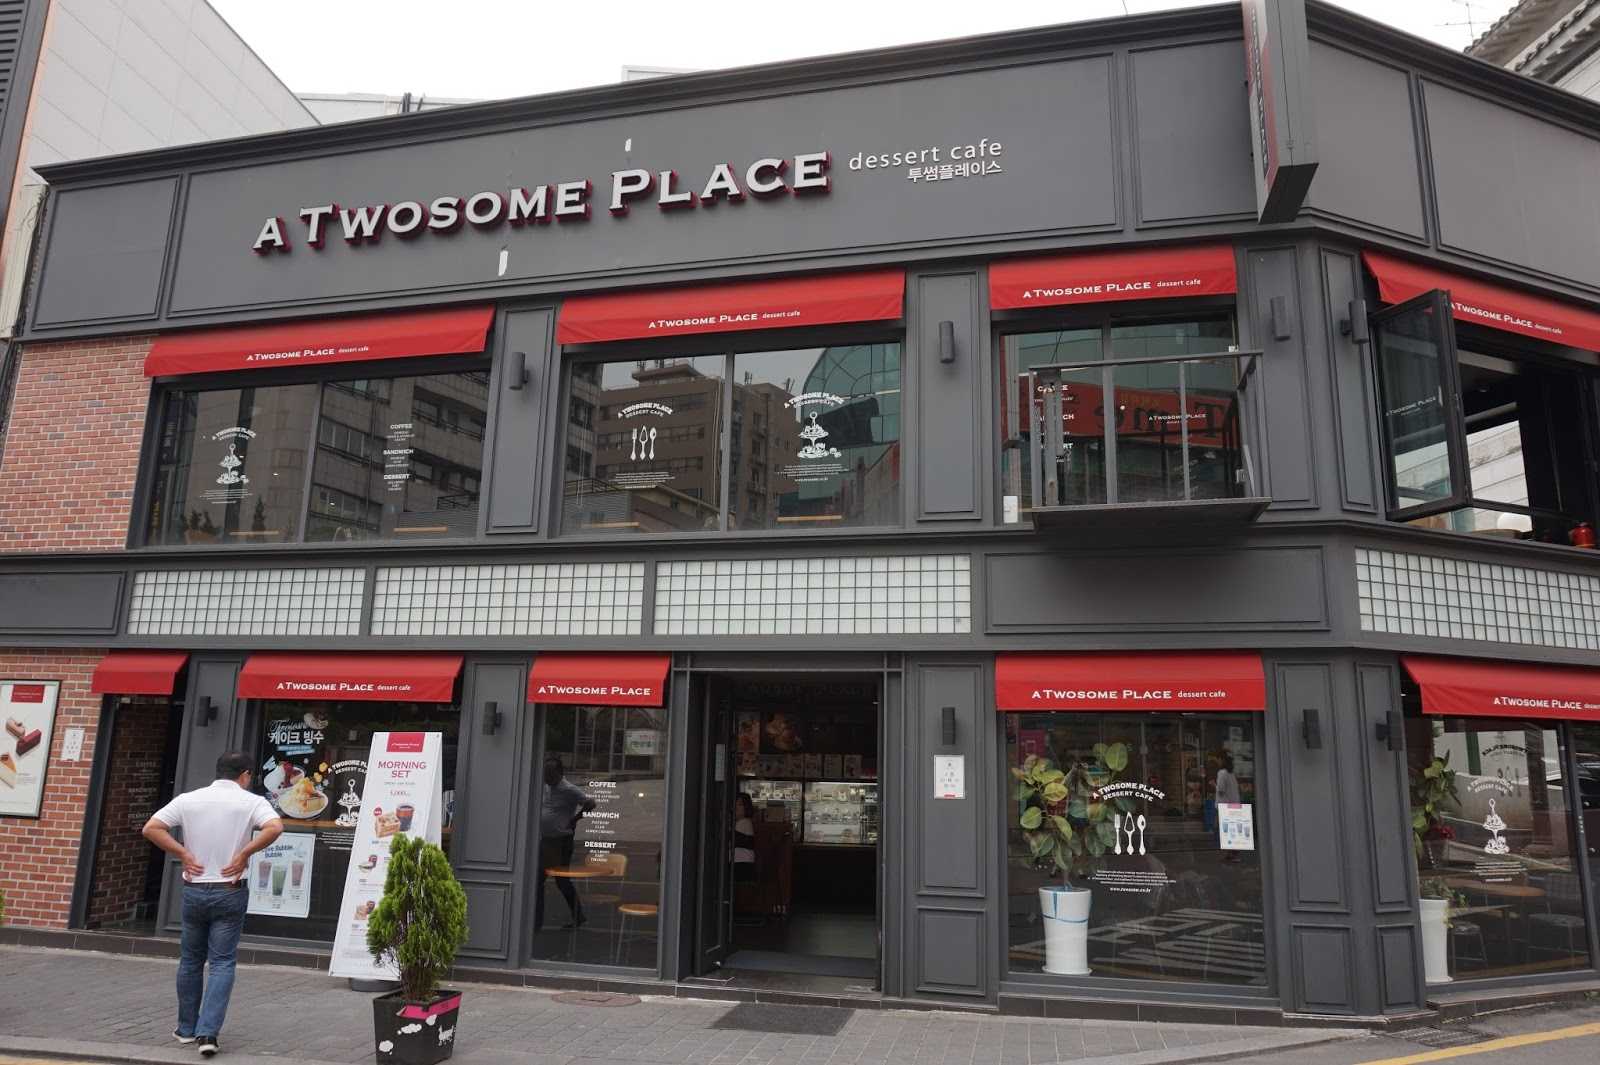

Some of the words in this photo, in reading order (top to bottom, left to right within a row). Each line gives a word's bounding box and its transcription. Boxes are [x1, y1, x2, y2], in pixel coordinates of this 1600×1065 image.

[849, 146, 940, 170] dessert
[950, 138, 1003, 160] cafe
[907, 161, 1002, 182] 투썸플레이스
[252, 216, 288, 251] A
[300, 178, 592, 247] TWOSOME
[608, 151, 830, 214] PLACE
[1023, 291, 1032, 299] A
[1033, 285, 1102, 297] TWOSOME
[1106, 281, 1151, 292] PLACE
[1186, 278, 1201, 286] cafe
[648, 321, 656, 329] A
[657, 316, 716, 328] TWOSOME
[719, 313, 758, 323] PLACE
[762, 311, 786, 319] dessert
[787, 310, 801, 318] cafe
[1455, 302, 1502, 321] TWOSOME
[1503, 314, 1533, 329] PLACE
[255, 351, 301, 361] TWOSOME
[303, 348, 335, 357] PLACE
[276, 682, 284, 690] A
[286, 681, 337, 691] TWOSOME
[339, 682, 374, 691] PLACE
[538, 686, 546, 694] A
[547, 685, 607, 695] TWOSOME
[611, 686, 651, 696] PLACE
[1031, 691, 1041, 699] A
[1042, 689, 1118, 699] TWOSOME
[1122, 689, 1172, 699] PLACE
[1177, 690, 1206, 698] dessert
[1208, 690, 1226, 698] cafe
[1494, 697, 1501, 705] A
[1501, 696, 1549, 708] TWOSOME
[1551, 699, 1582, 710] PLACE
[270, 731, 301, 745] 케이크
[303, 730, 325, 745] 빙수
[378, 760, 427, 770] MORNING
[391, 770, 411, 778] SET
[1092, 791, 1100, 800] A
[1098, 782, 1138, 795] TWOSOME
[1138, 783, 1166, 800] PLACE
[1103, 790, 1133, 801] DESSERT
[1134, 791, 1154, 802] CAFE
[582, 811, 620, 819] SANDWICH
[584, 841, 617, 849] DESSERT
